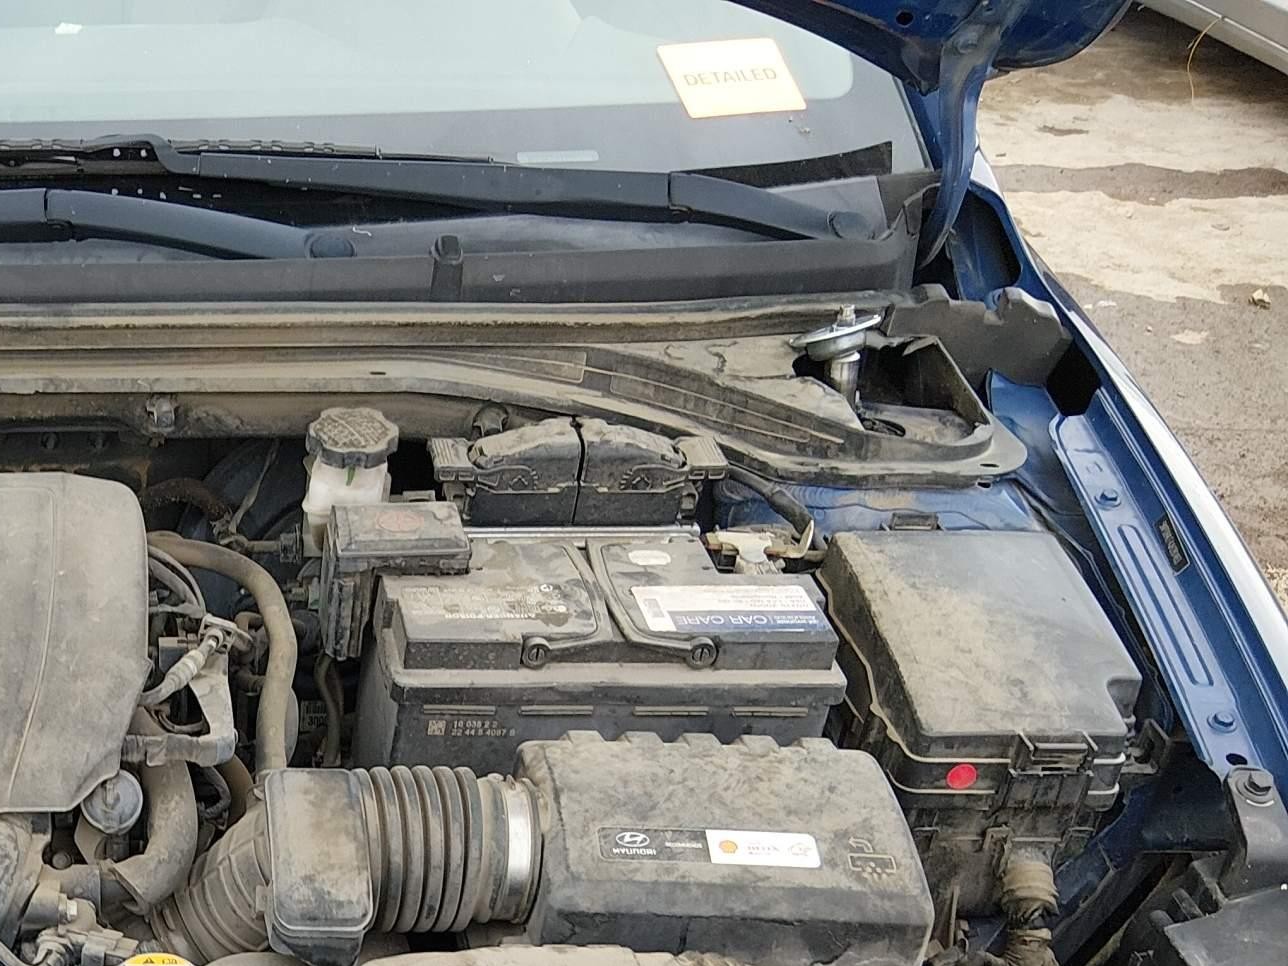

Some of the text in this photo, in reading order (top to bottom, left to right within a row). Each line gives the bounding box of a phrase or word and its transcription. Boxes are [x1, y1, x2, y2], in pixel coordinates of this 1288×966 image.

[683, 67, 778, 87] DETAILED
[678, 615, 725, 625] CARE
[728, 614, 768, 625] CAR
[612, 848, 657, 856] HYUNDAI
